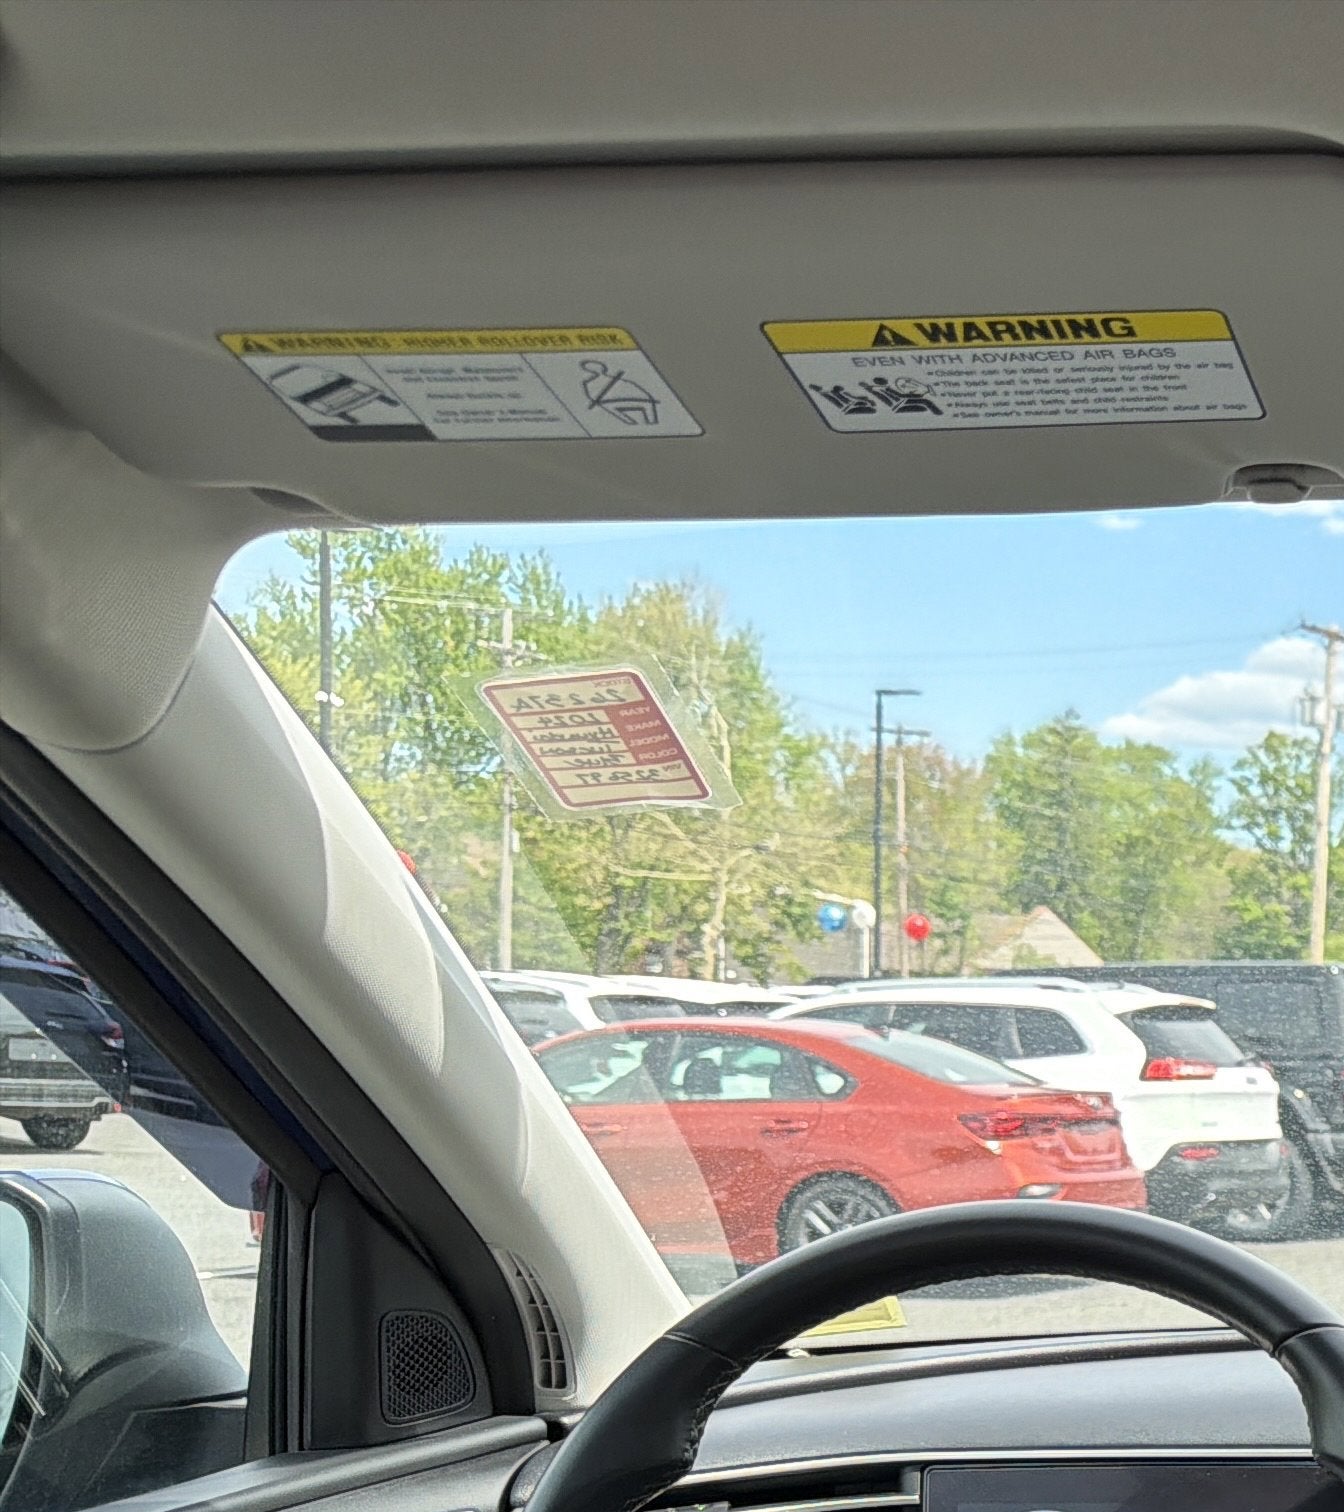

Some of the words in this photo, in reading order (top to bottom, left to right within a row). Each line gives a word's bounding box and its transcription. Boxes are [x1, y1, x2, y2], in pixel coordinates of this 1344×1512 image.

[913, 317, 1138, 343] WARNING
[852, 356, 906, 369] EVEN
[910, 353, 963, 366] WITH
[972, 350, 1075, 364] ADVANCED
[1083, 348, 1115, 360] AIR
[1123, 347, 1177, 359] BAGS
